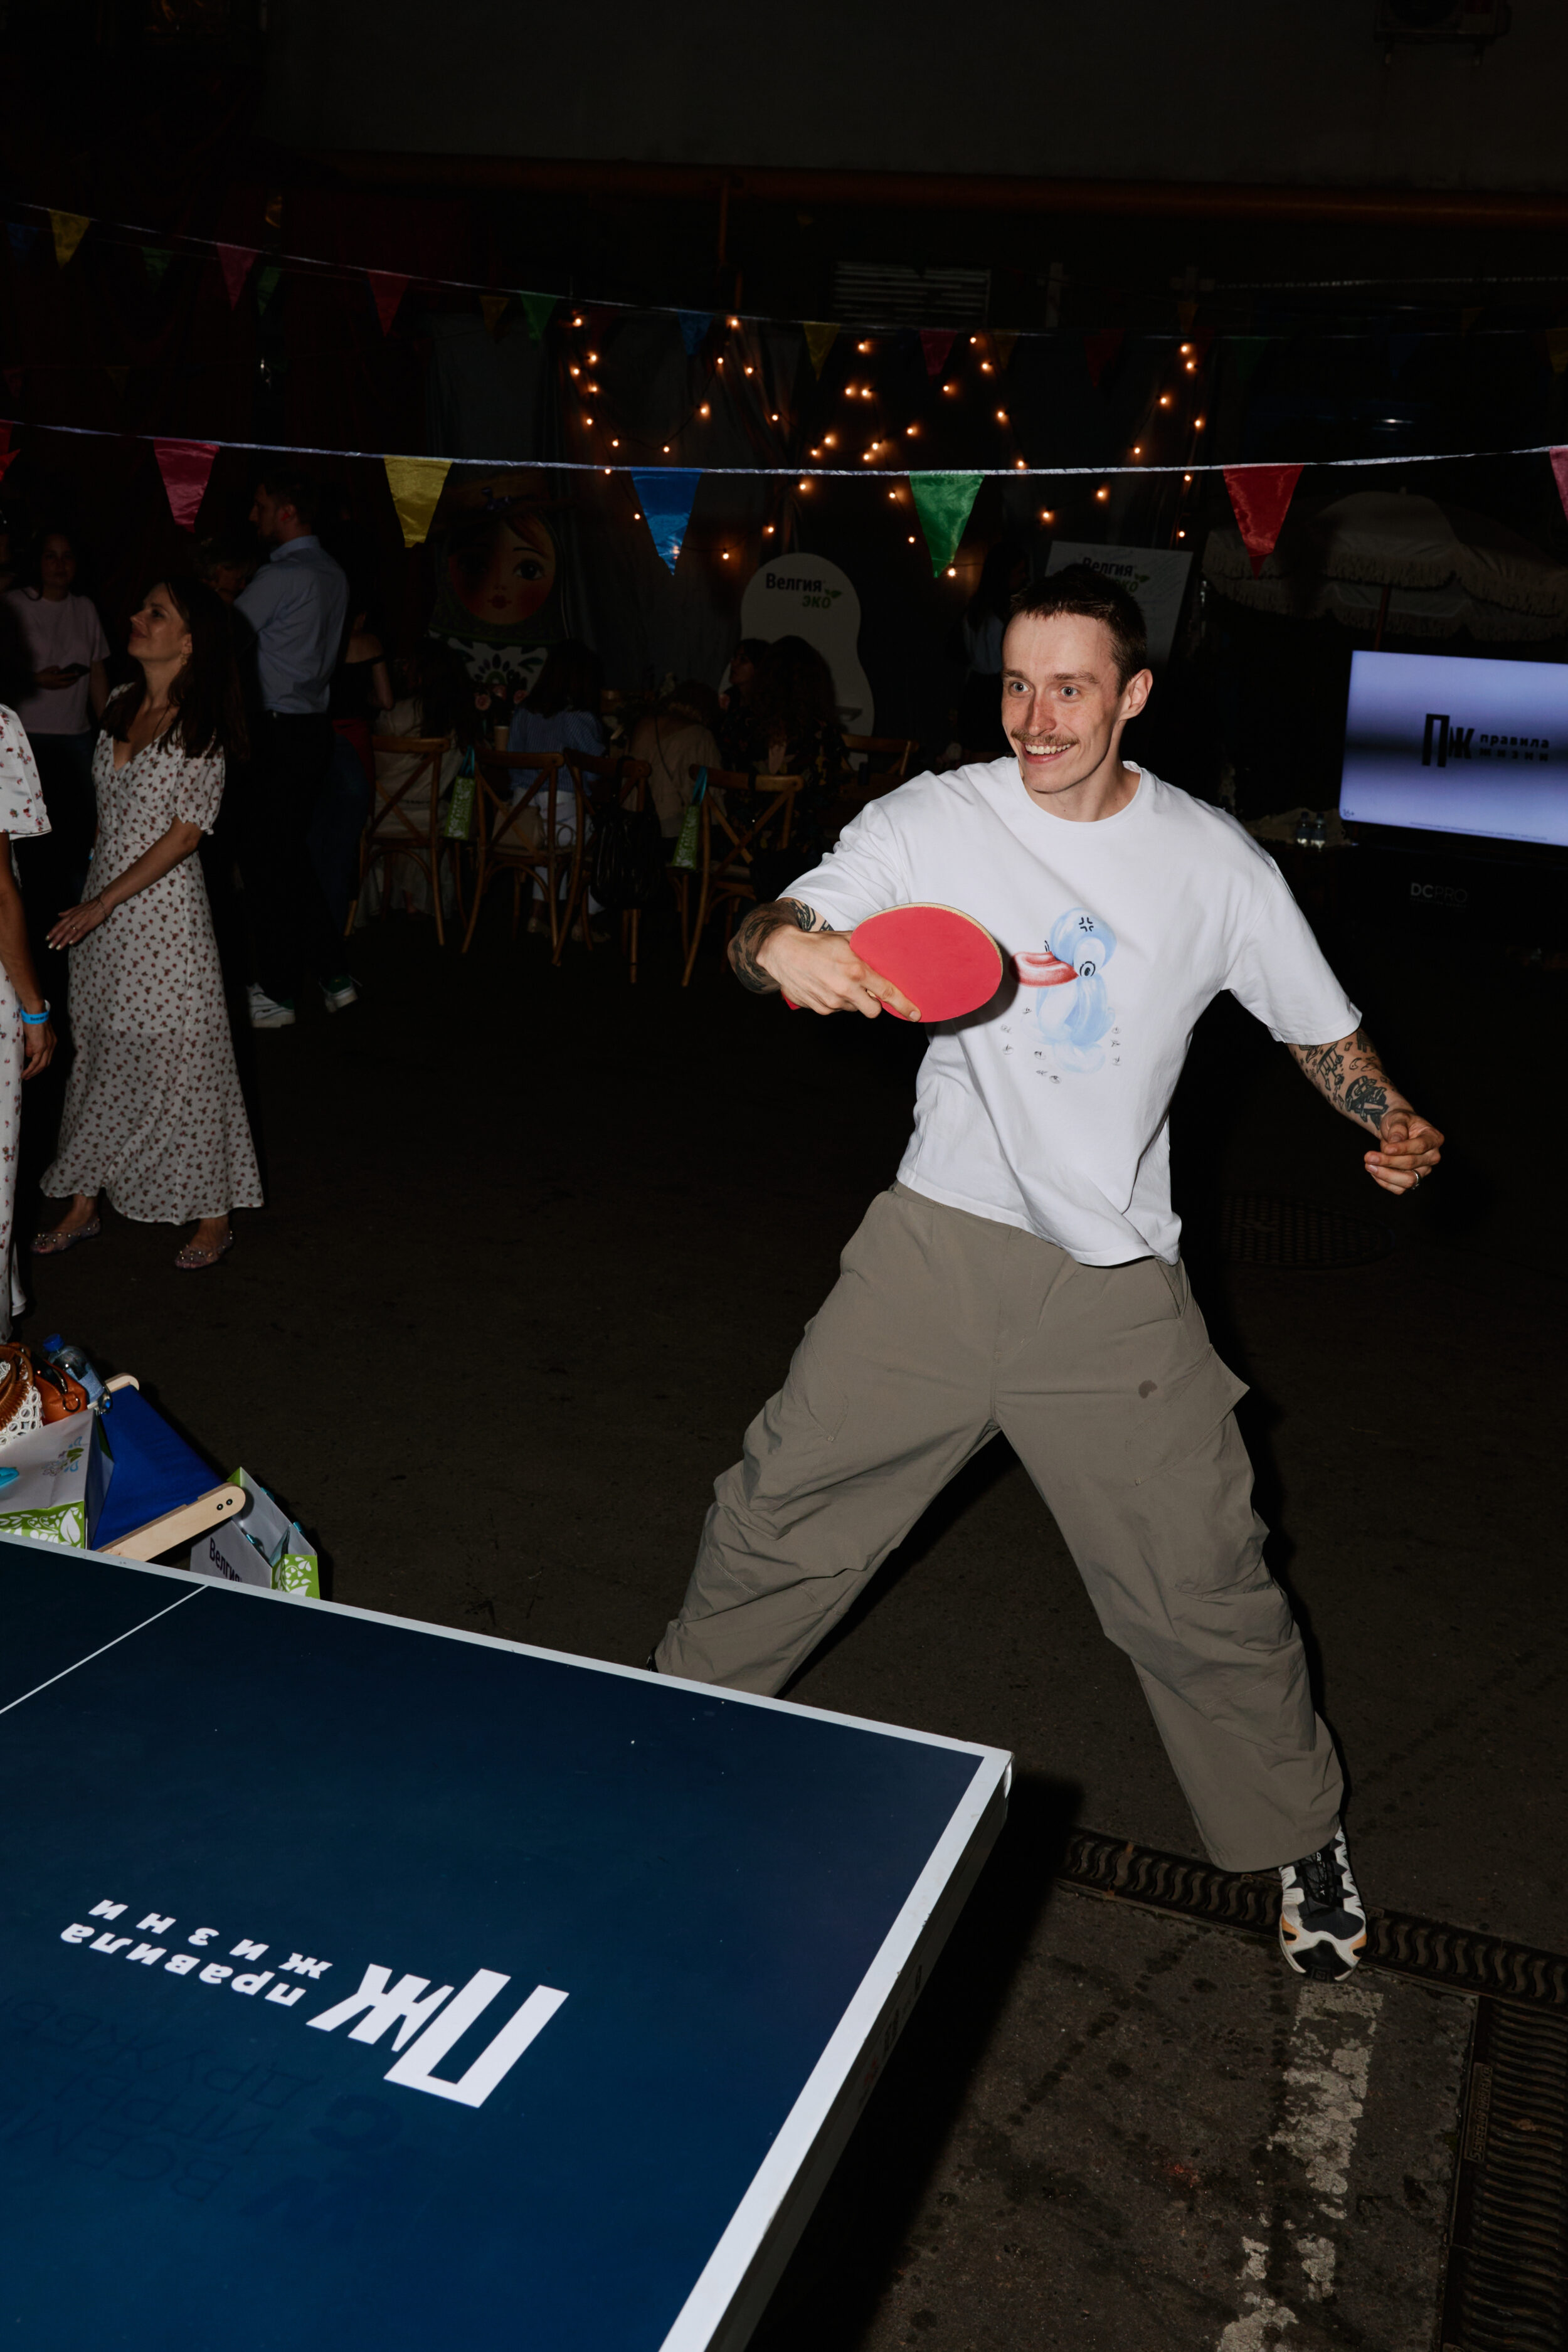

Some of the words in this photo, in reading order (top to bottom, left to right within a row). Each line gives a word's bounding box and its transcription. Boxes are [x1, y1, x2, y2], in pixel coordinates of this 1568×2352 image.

[766, 573, 822, 592] Велгия
[1421, 713, 1475, 767] ПЖ
[1479, 747, 1549, 762] жизни
[1480, 734, 1550, 749] правила
[61, 1923, 306, 2006] правила
[88, 1899, 333, 1979] жизни
[306, 1963, 569, 2108] ПЖ
